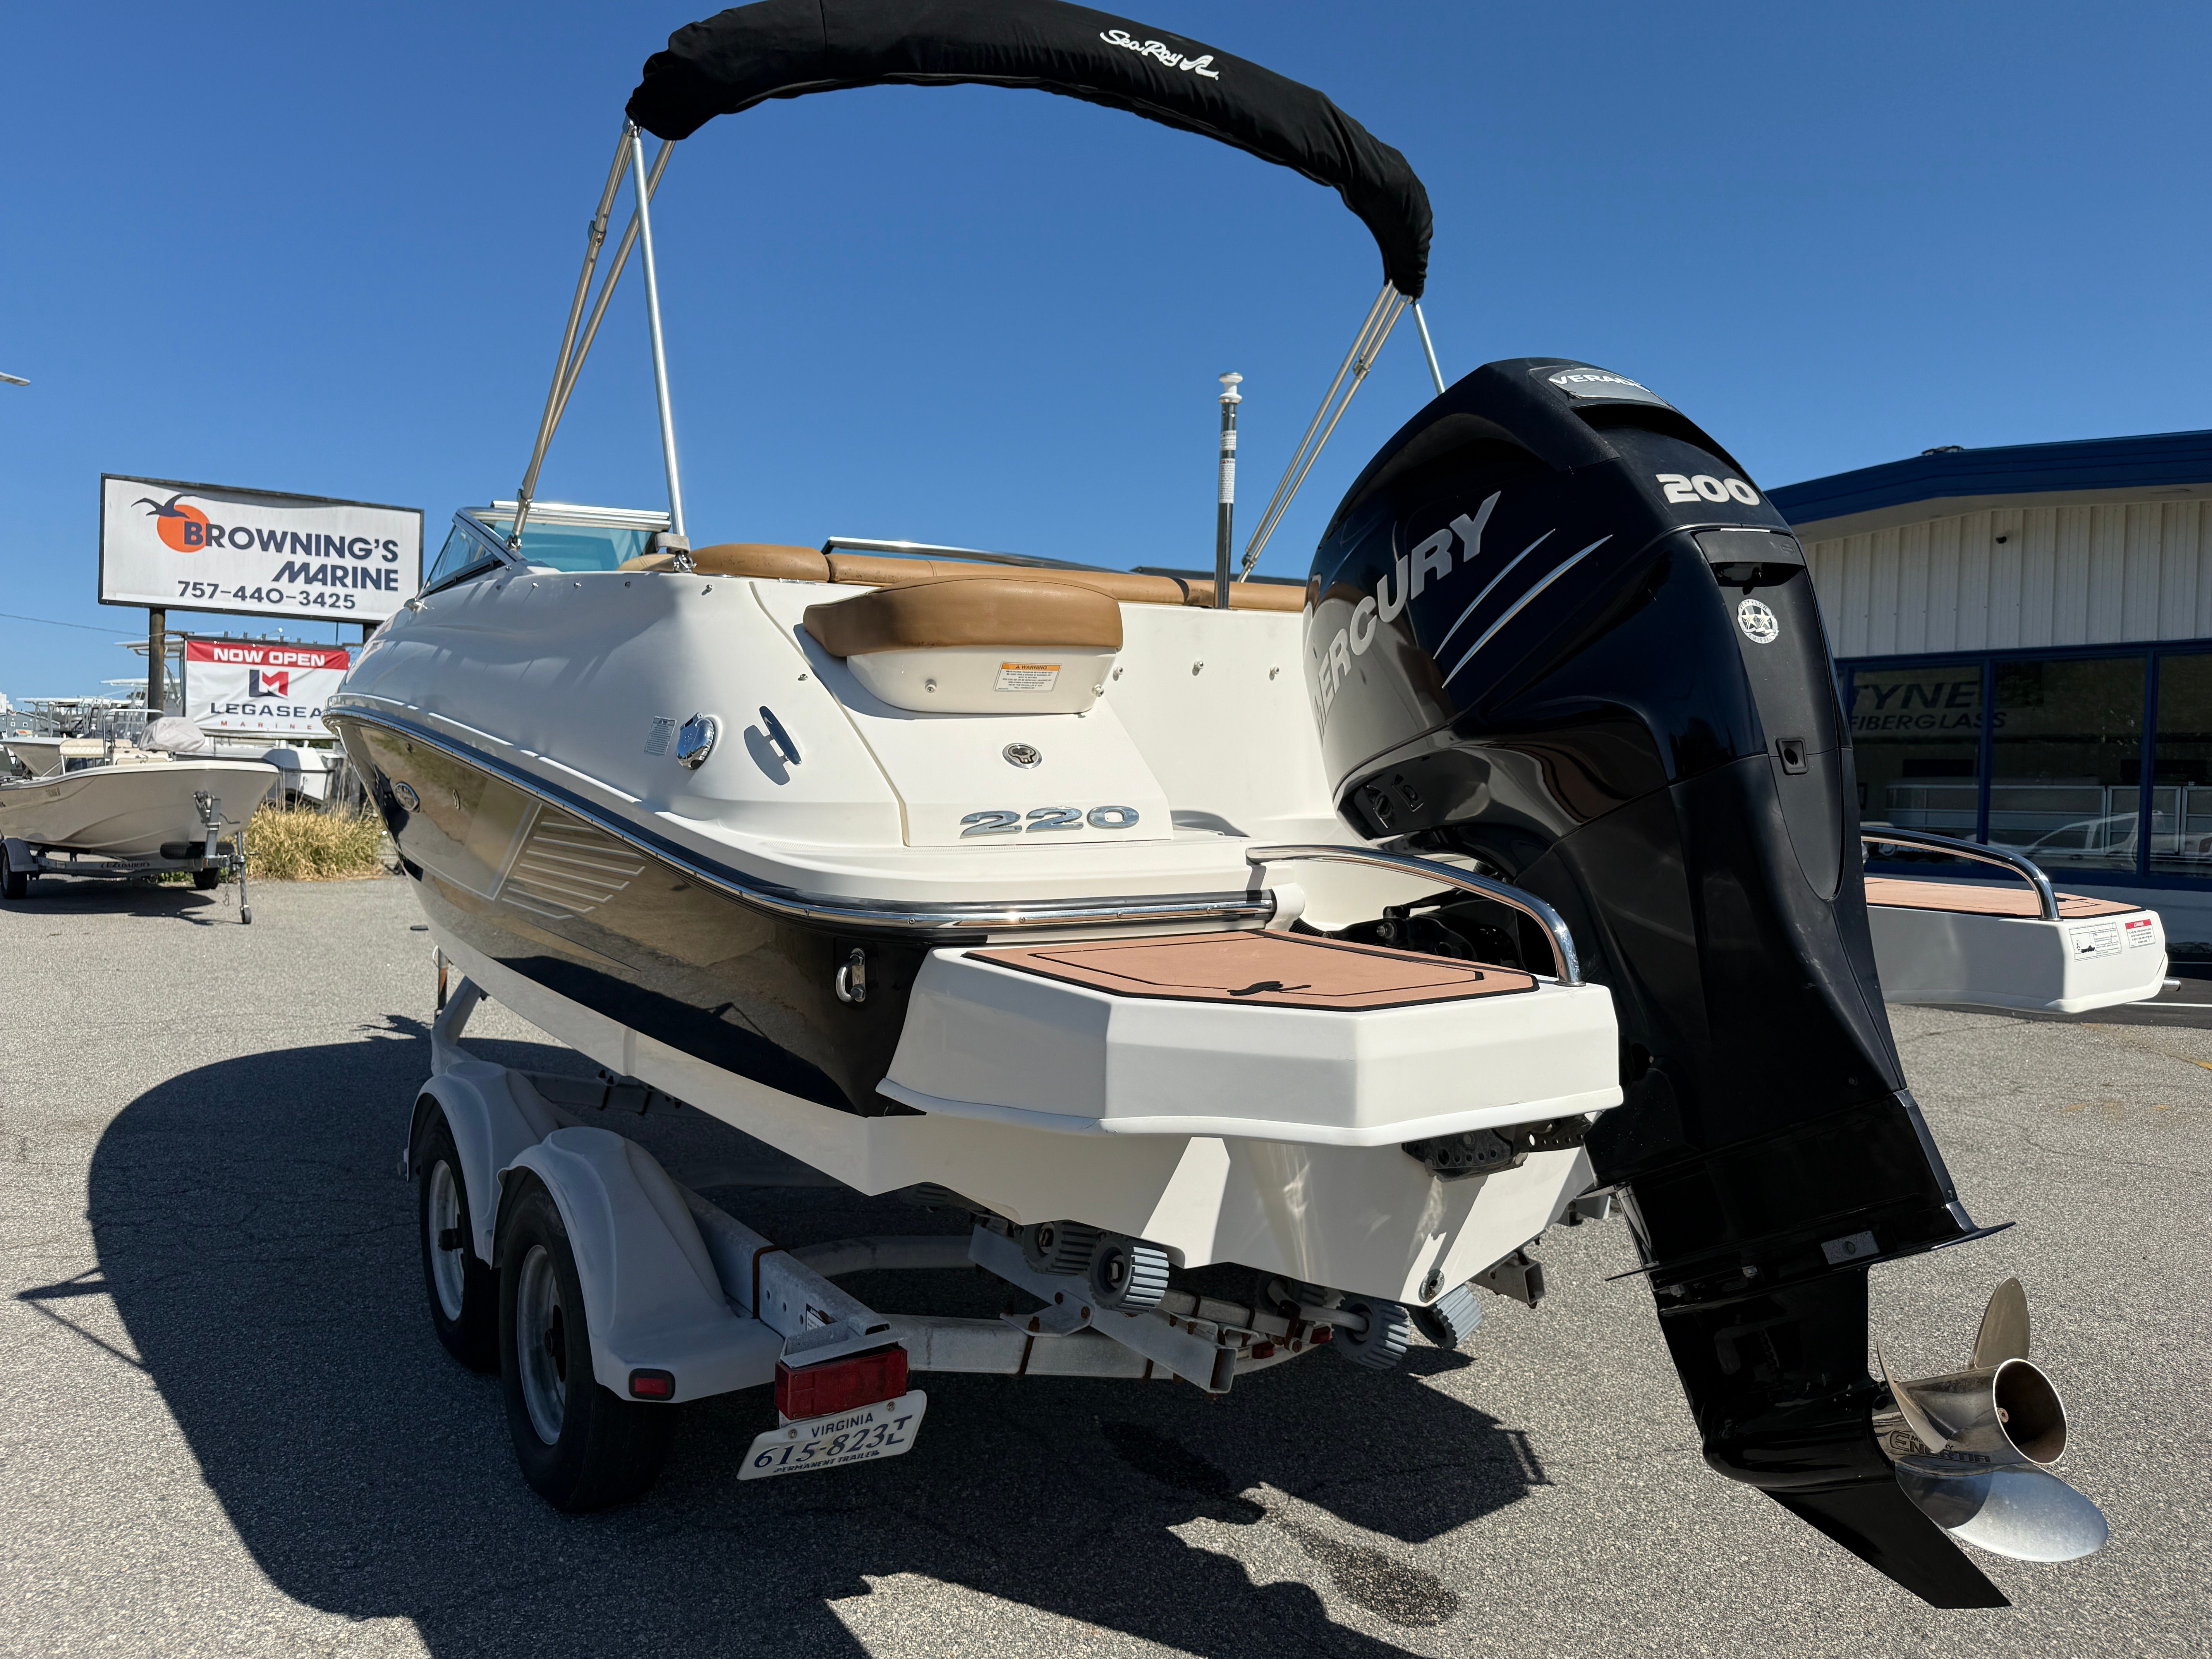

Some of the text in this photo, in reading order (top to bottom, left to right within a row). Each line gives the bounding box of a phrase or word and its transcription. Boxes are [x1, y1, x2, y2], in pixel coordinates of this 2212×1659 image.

[1655, 474, 1760, 506] 200
[184, 521, 398, 562] BROWNING'S
[271, 561, 398, 591] MARINE
[177, 580, 356, 610] 757-440-3425
[1314, 491, 1501, 747] MERCURY
[213, 648, 325, 667] NOW OPEN
[211, 702, 322, 718] LEGASEA
[220, 720, 312, 730] MARINE
[959, 805, 1140, 839] 220
[811, 1412, 874, 1438] VIRGINIA
[774, 1449, 880, 1473] PERMANENT TRAILER
